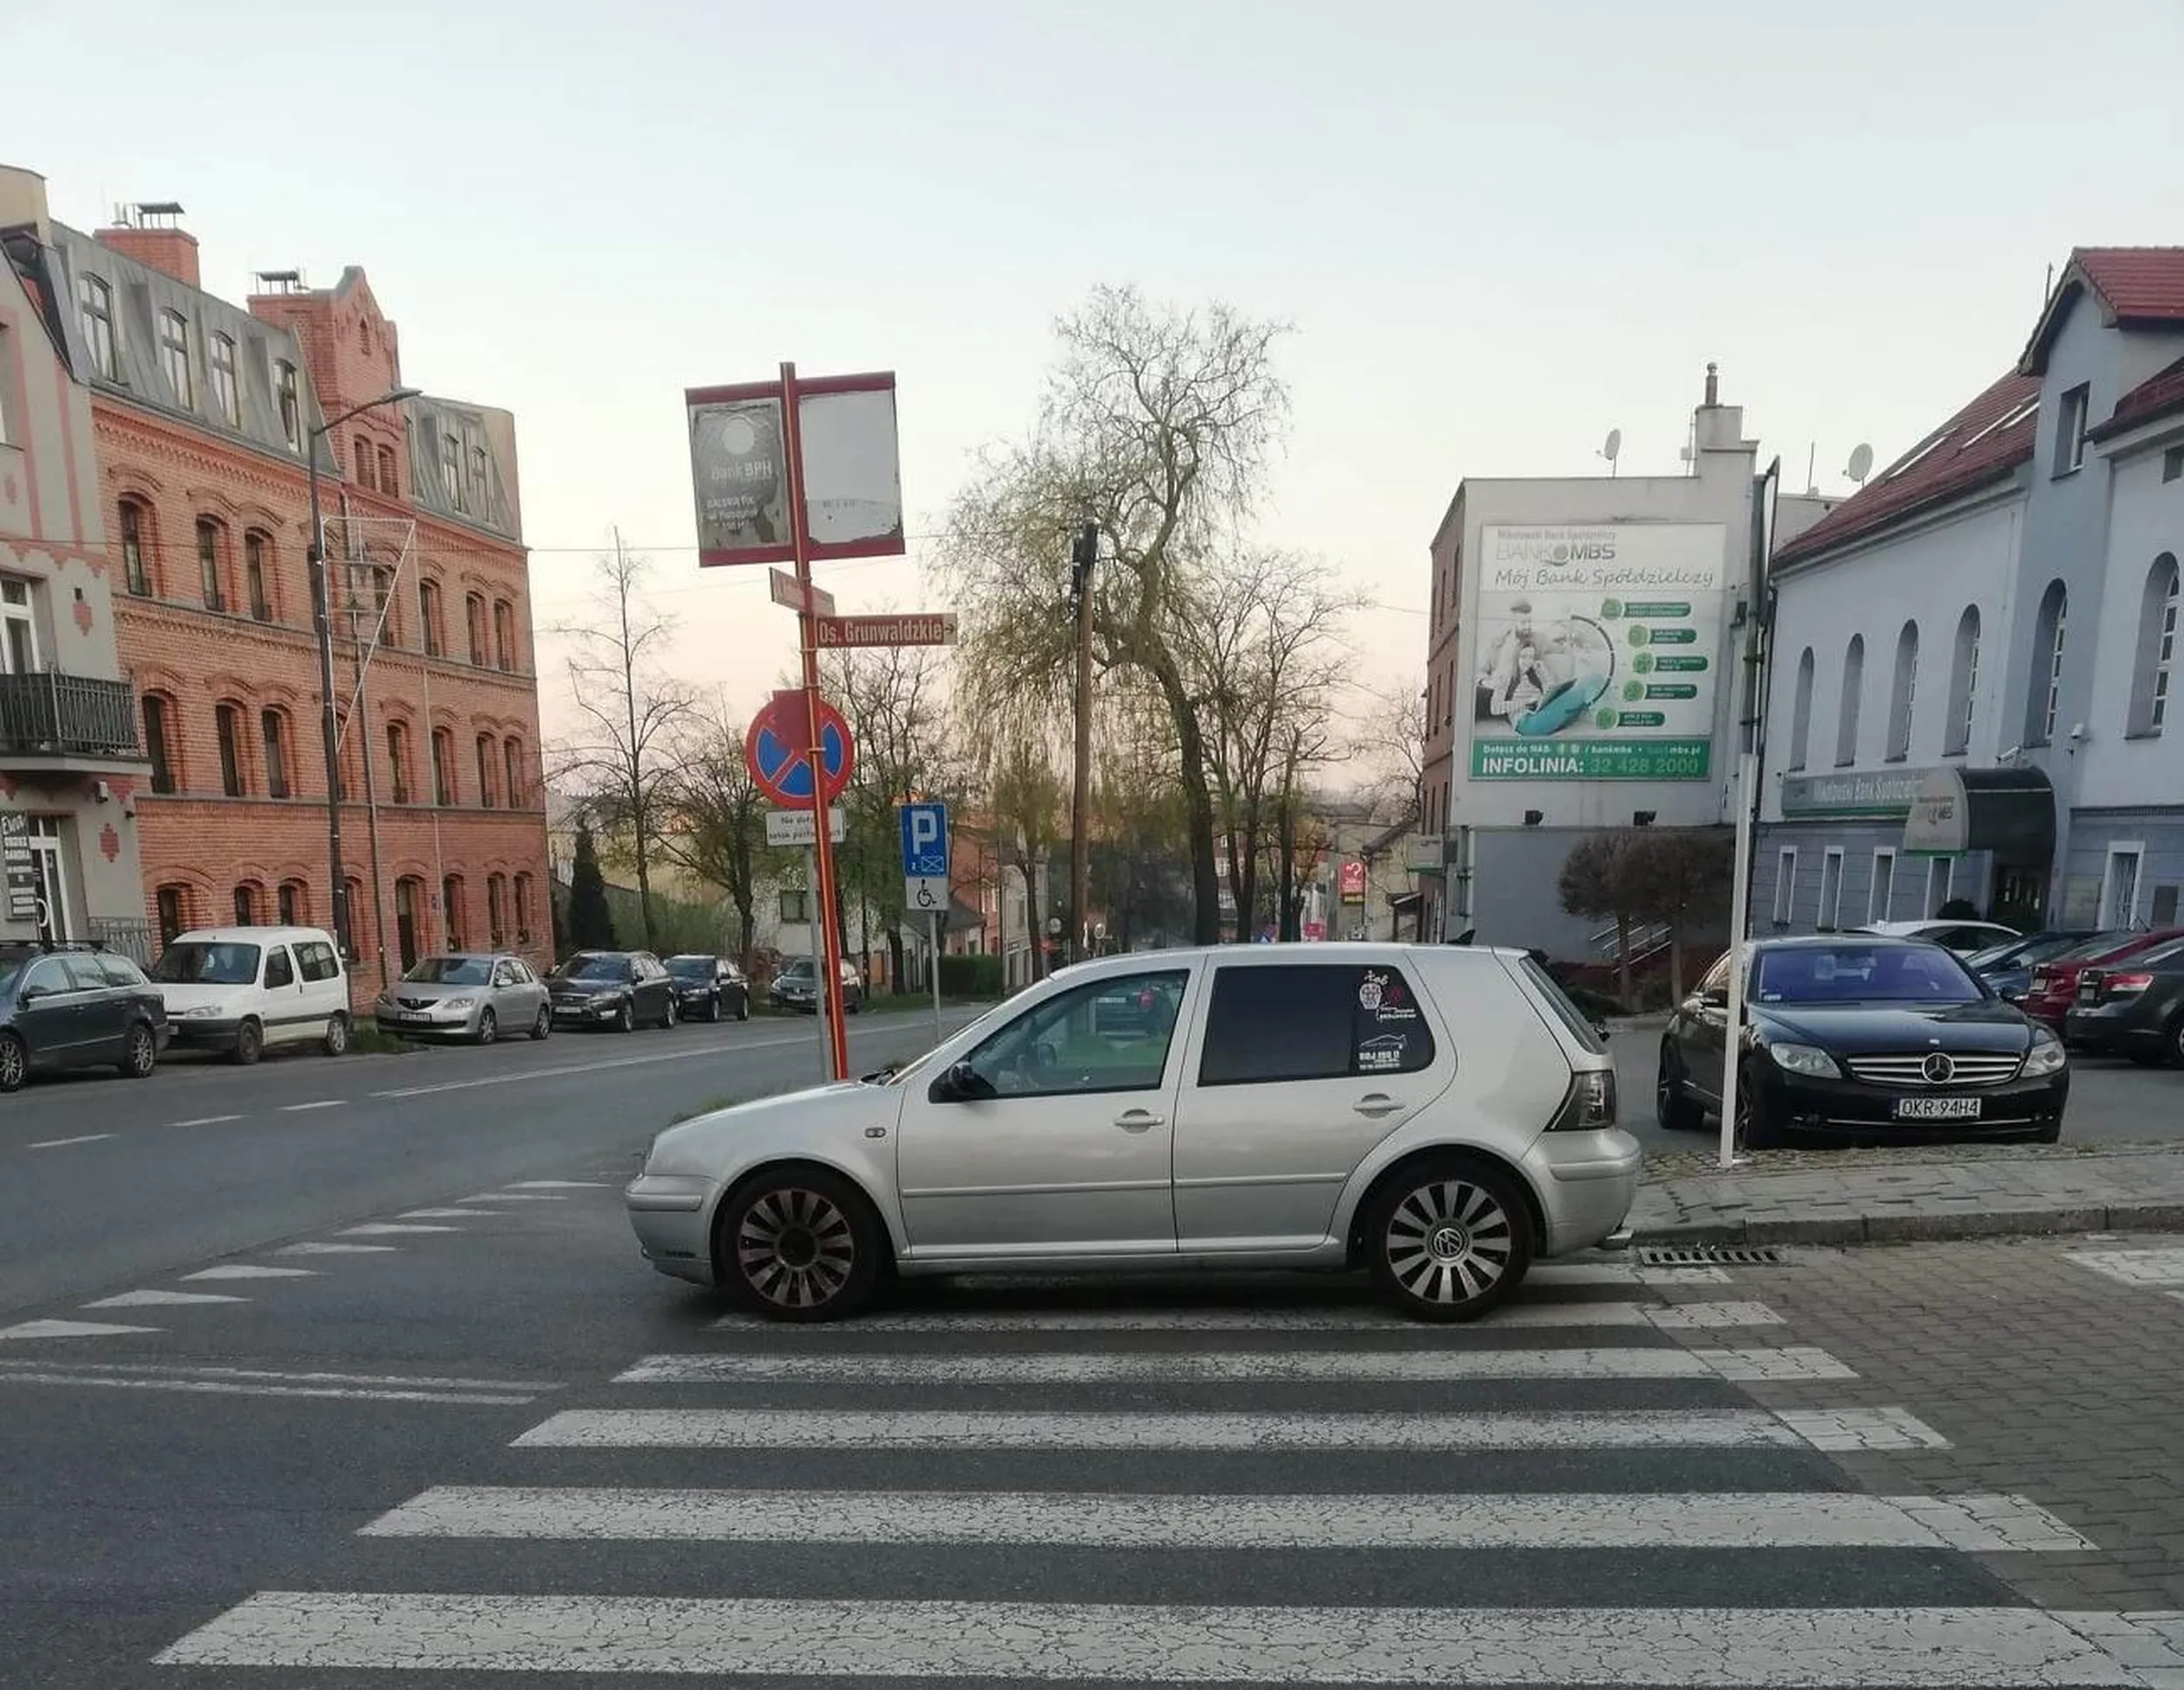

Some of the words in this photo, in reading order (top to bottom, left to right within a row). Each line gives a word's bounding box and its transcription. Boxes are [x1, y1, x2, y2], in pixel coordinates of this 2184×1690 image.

[744, 459, 772, 477] BPH
[1570, 541, 1616, 560] MBS
[1495, 569, 1530, 589] Mój
[1536, 568, 1587, 586] Bank
[1593, 566, 1713, 588] Spółdzielczy
[819, 621, 841, 644] Os.
[845, 618, 943, 643] Grunwaldzkie
[1482, 757, 1584, 774] INFOLINIA:
[1590, 757, 1612, 774] 32
[1617, 757, 1649, 774] 428
[1656, 757, 1698, 774] 2000
[911, 810, 937, 855] P
[1939, 1100, 1979, 1115] 94H4
